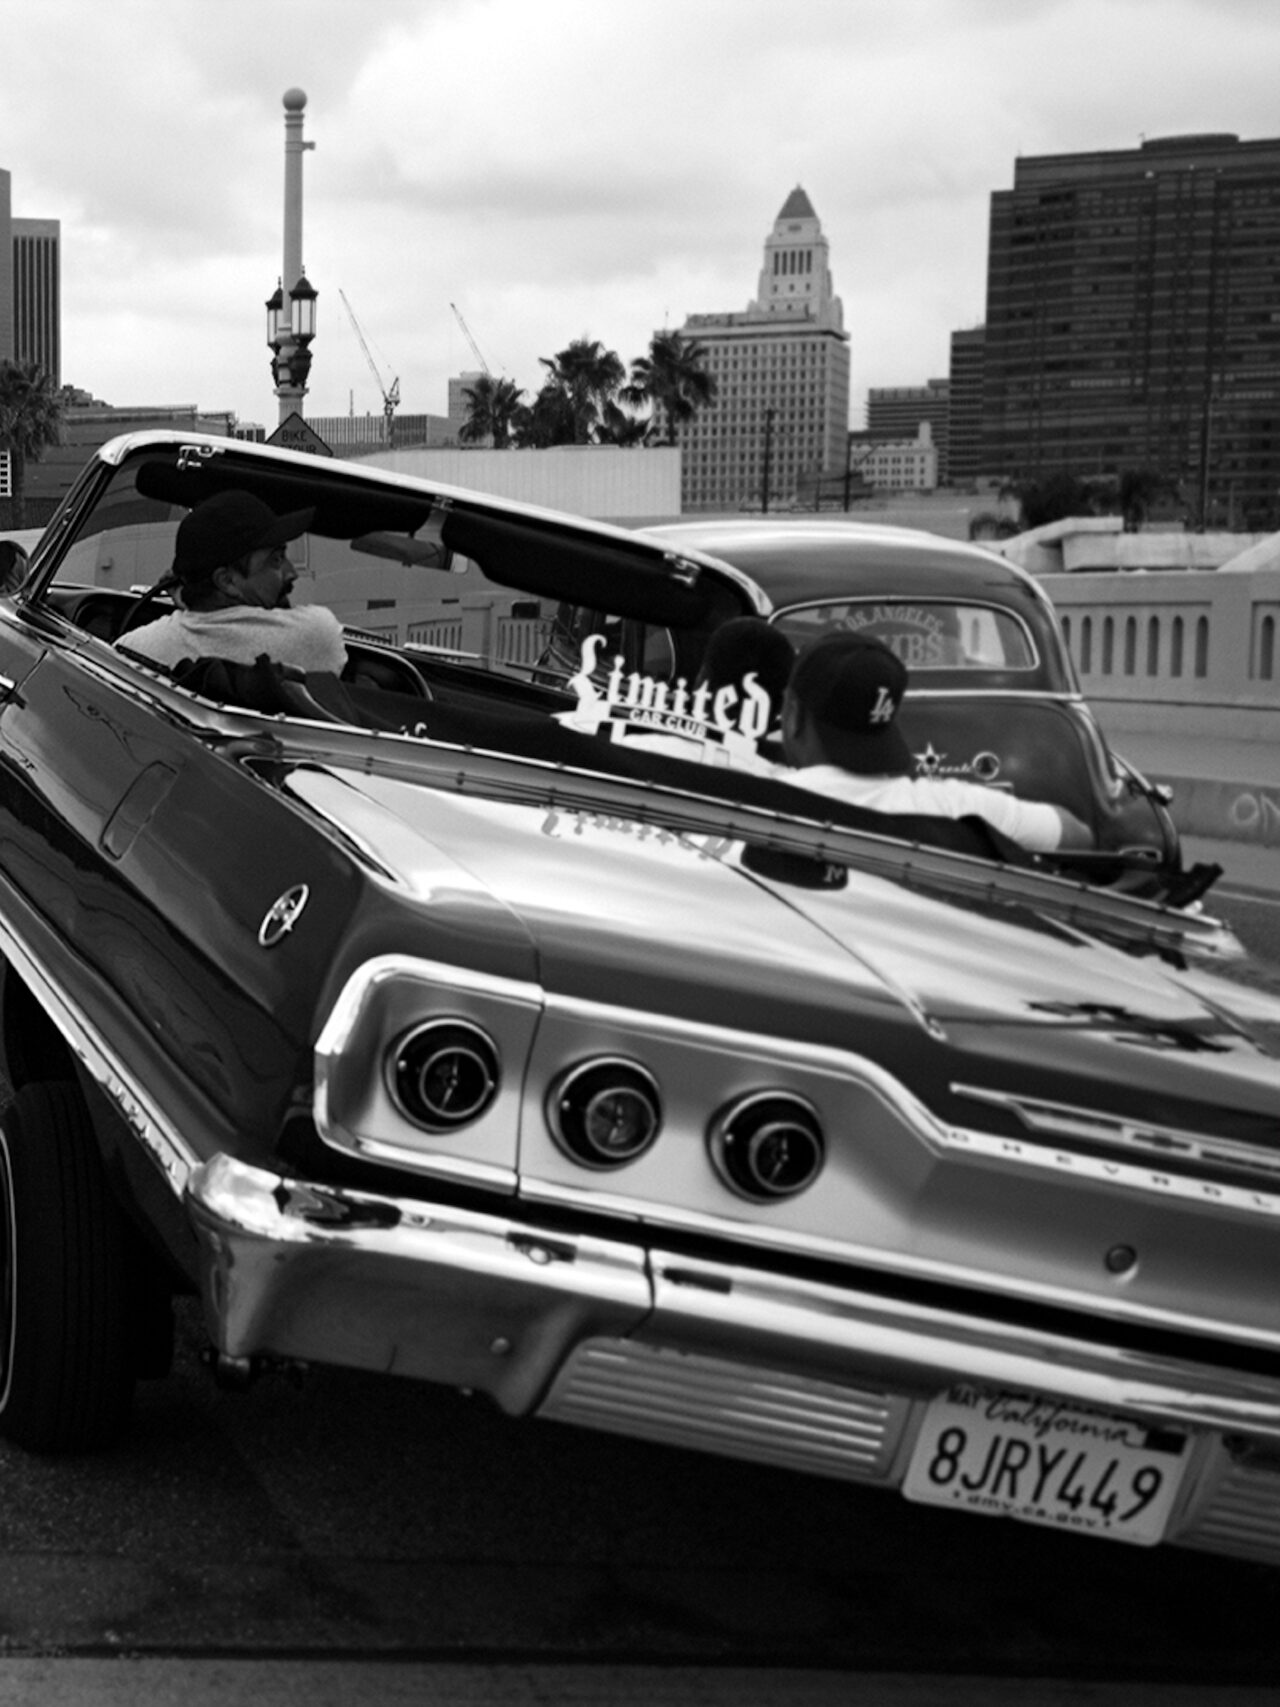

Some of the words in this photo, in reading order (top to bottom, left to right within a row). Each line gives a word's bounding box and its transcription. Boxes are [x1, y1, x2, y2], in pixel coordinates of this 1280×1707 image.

[281, 429, 307, 442] BIKE
[871, 606, 945, 636] ANGELES
[567, 634, 771, 738] Limited
[630, 707, 663, 725] CAR
[668, 714, 708, 738] CLUB
[984, 1395, 1143, 1448] California
[927, 1427, 1163, 1522] 8JRY449
